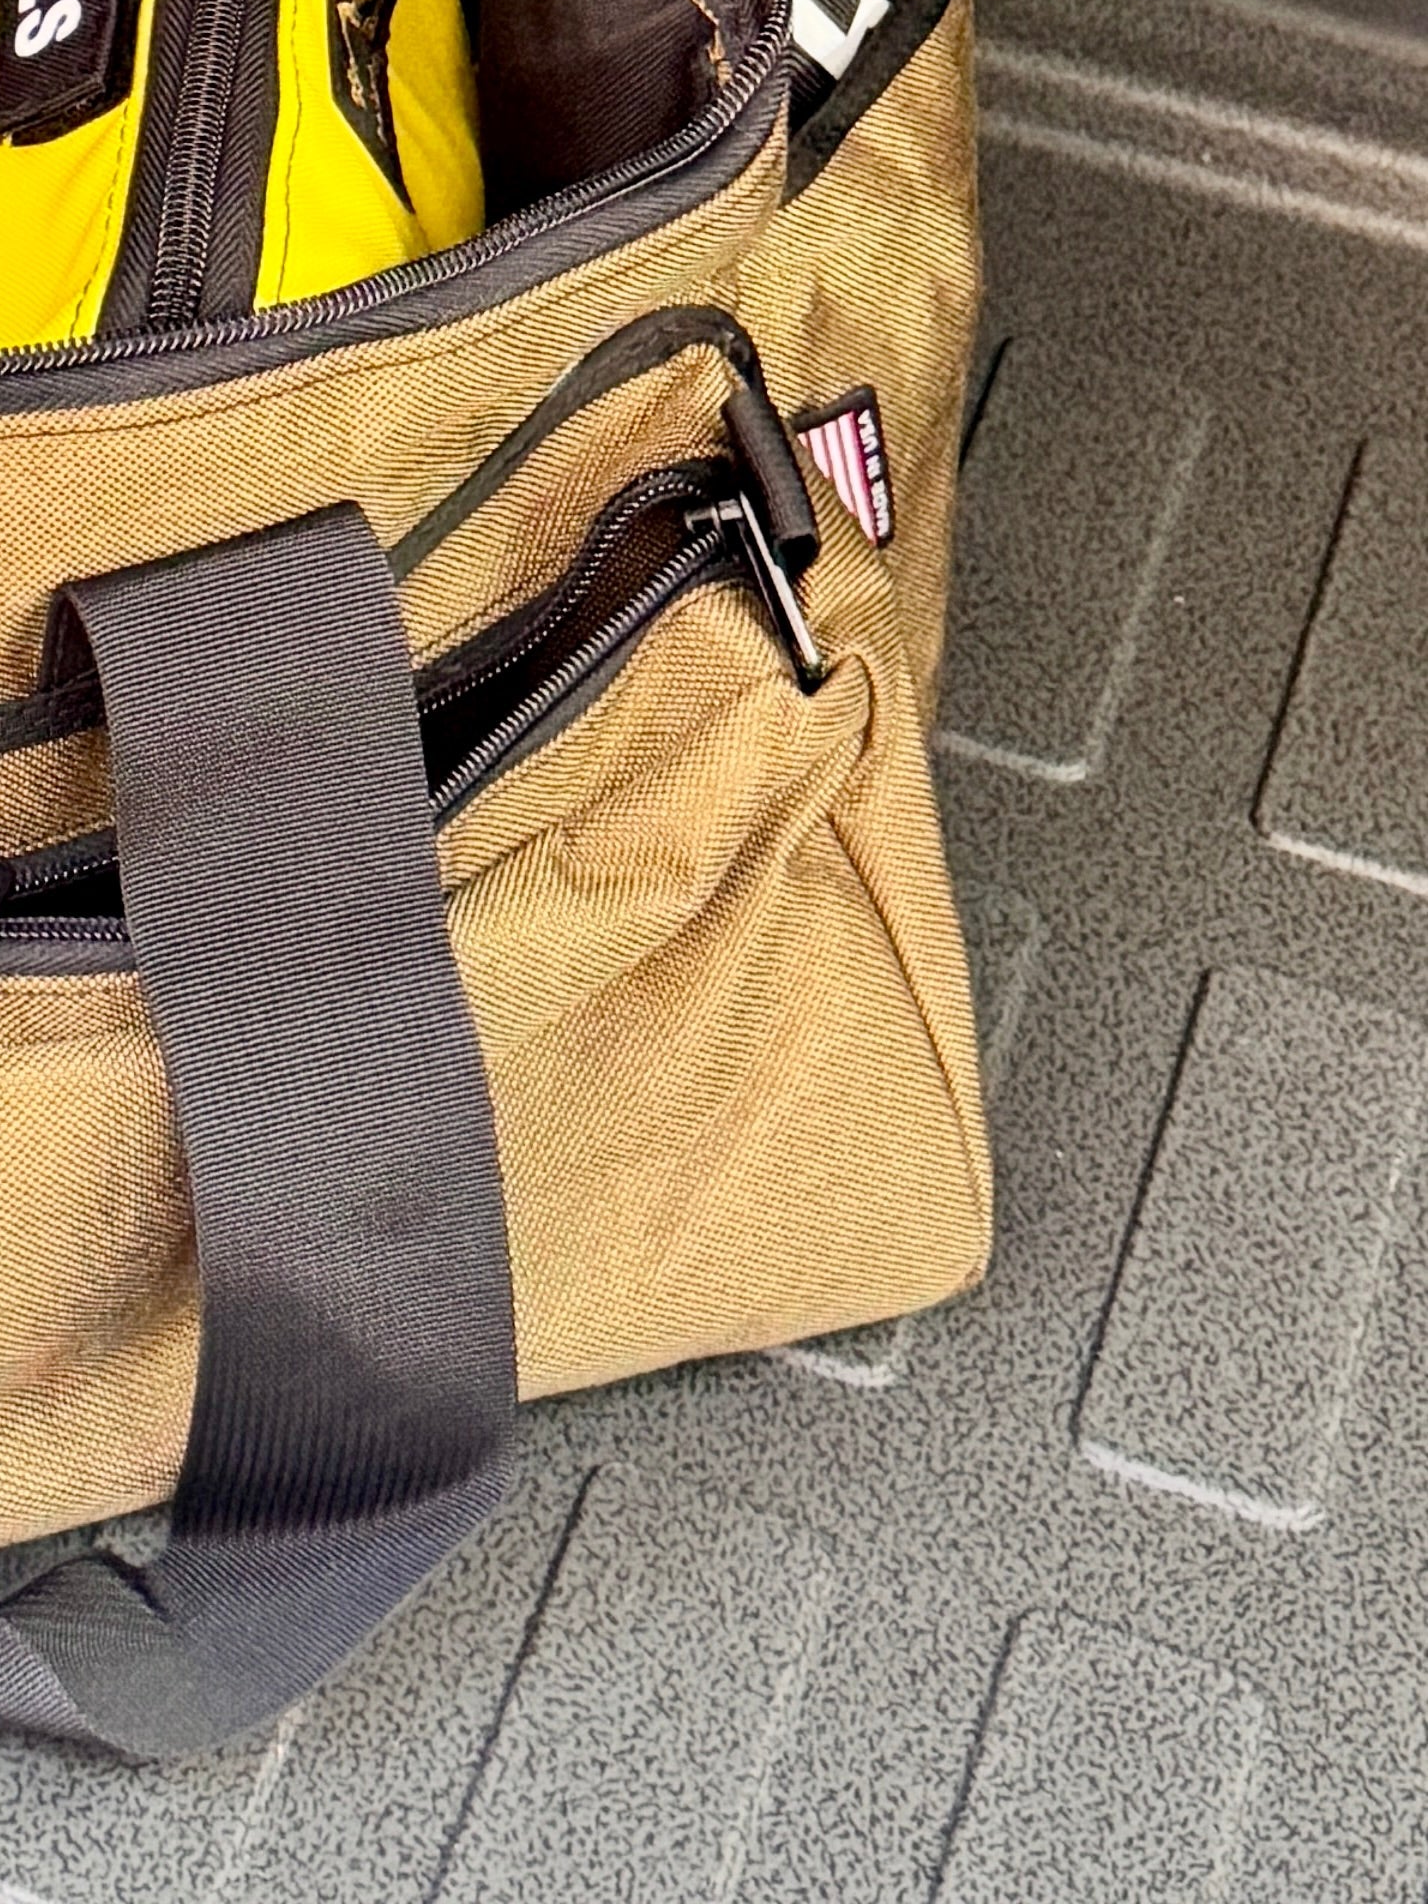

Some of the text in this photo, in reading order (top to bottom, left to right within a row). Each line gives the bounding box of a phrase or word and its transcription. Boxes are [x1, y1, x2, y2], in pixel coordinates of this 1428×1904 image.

[857, 408, 891, 538] MADE IN USA
